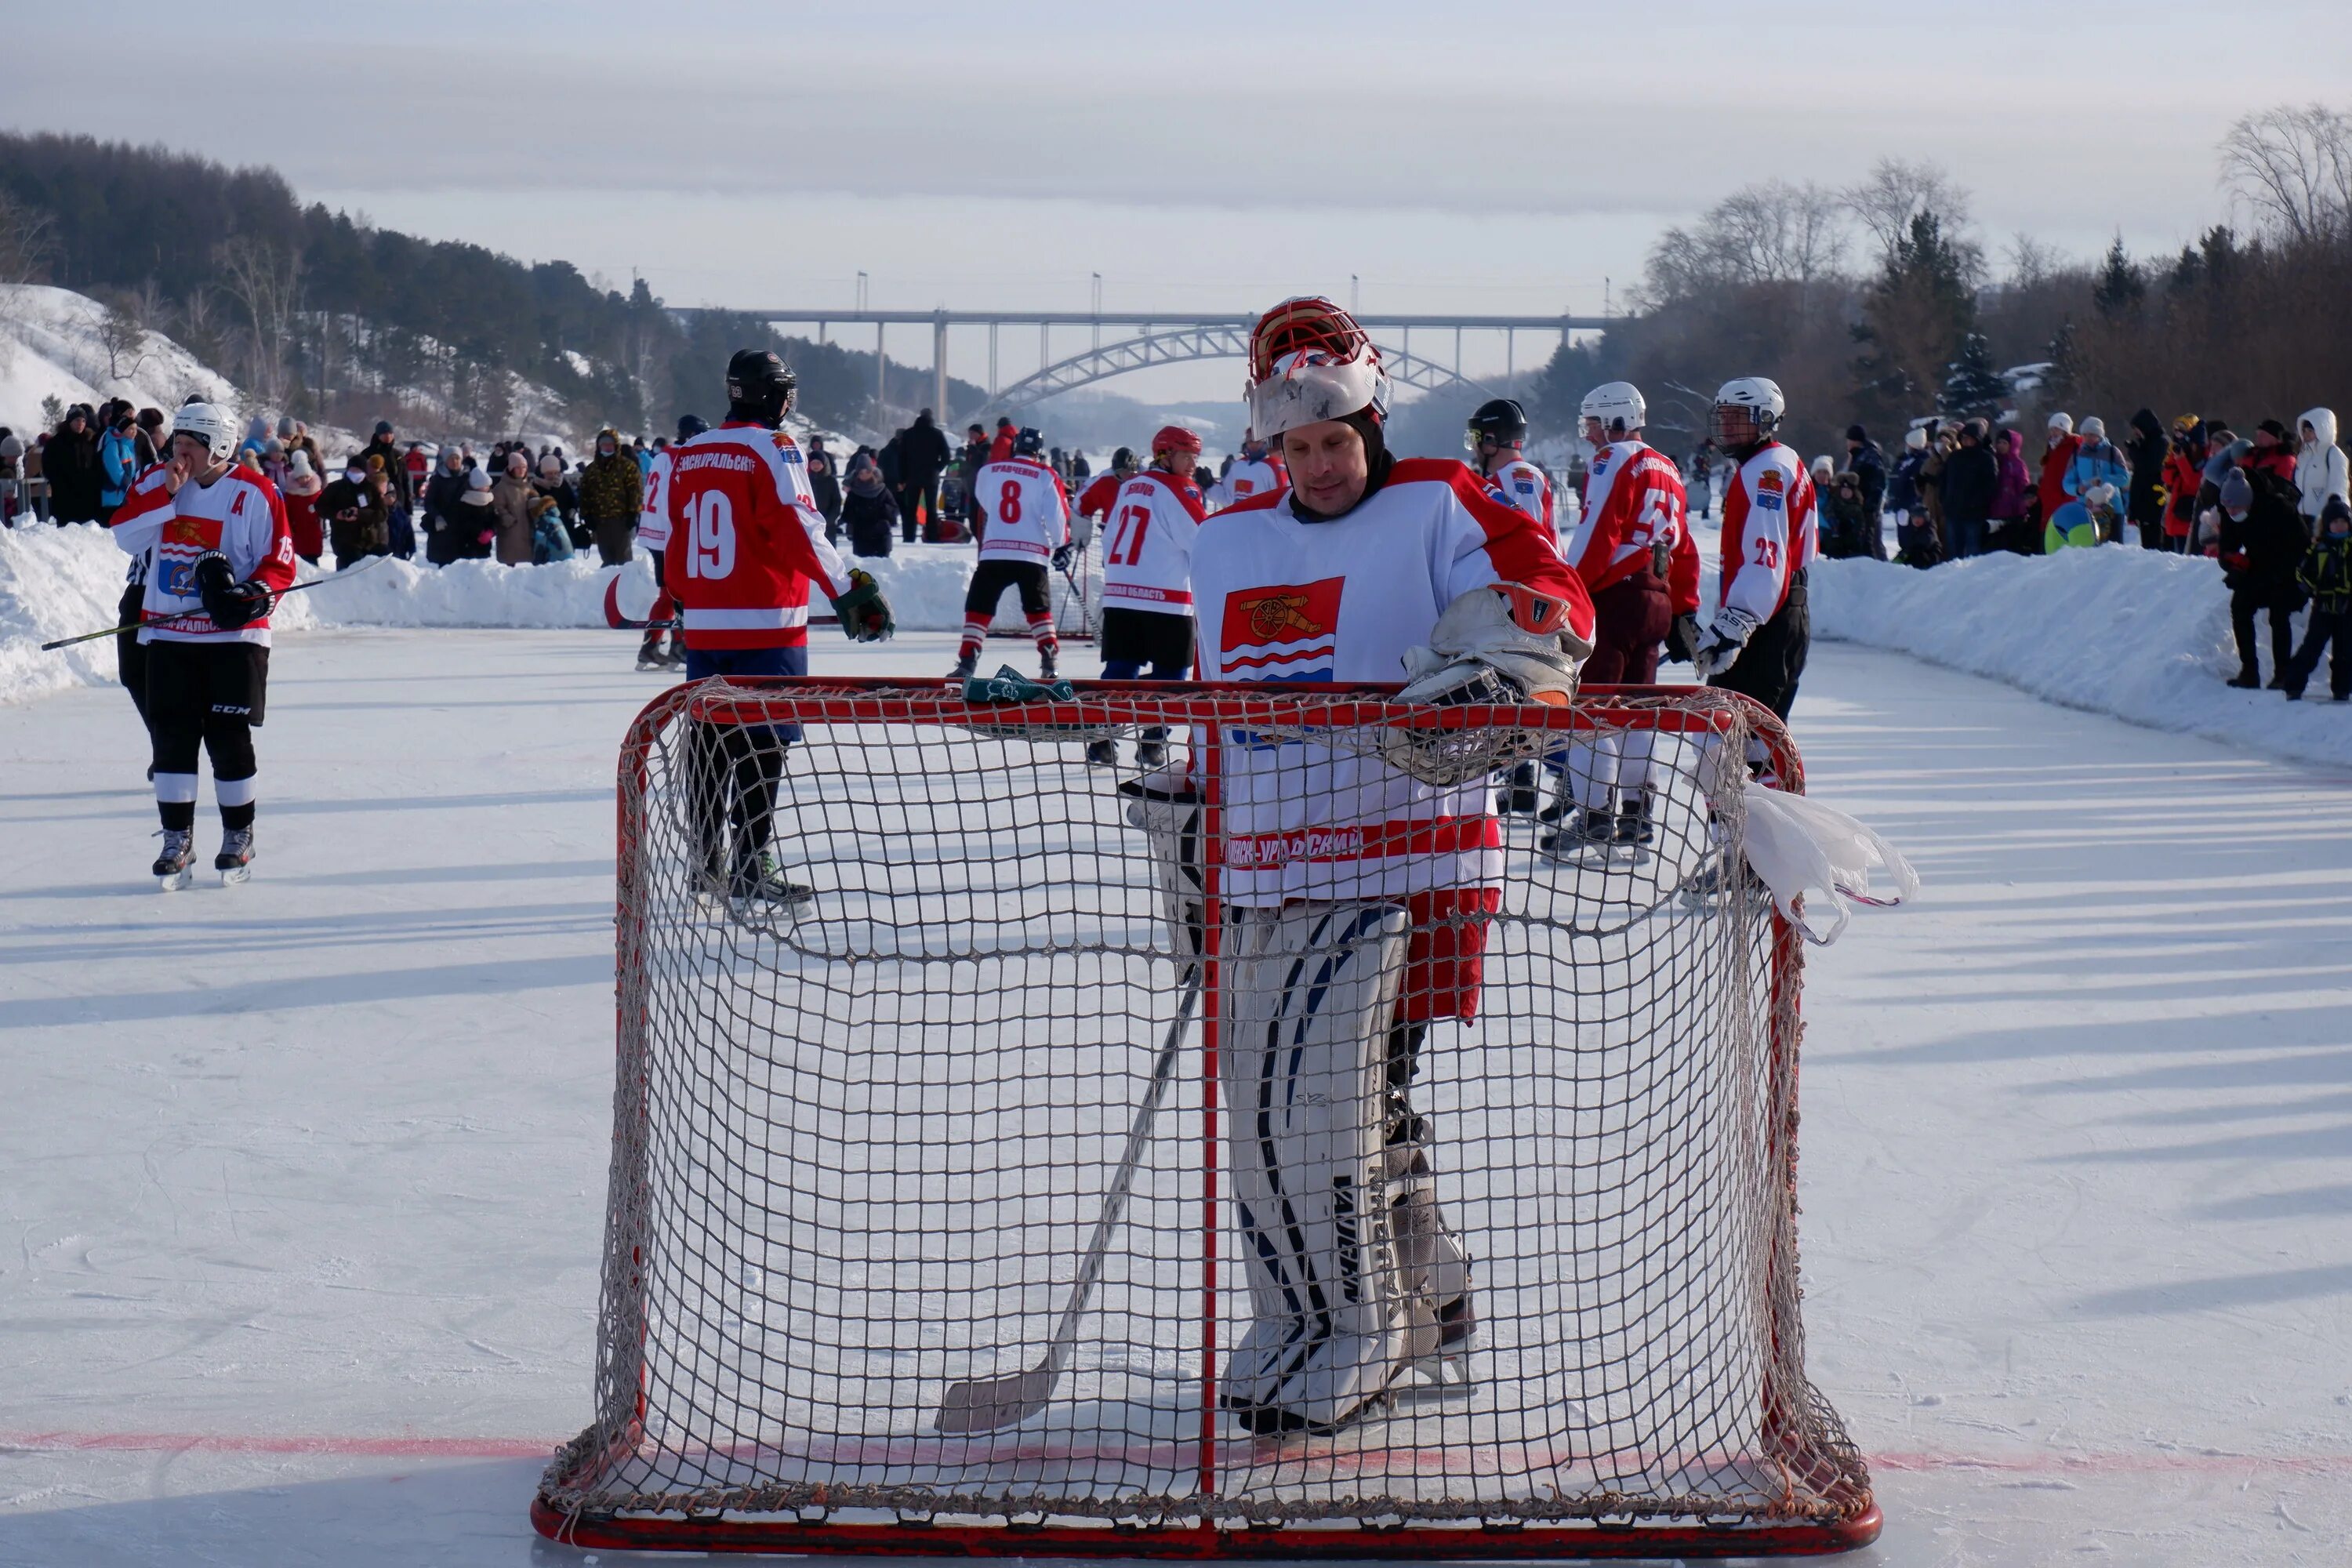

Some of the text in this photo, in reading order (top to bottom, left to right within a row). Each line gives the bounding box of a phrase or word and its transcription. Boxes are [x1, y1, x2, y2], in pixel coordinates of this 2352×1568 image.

[1000, 480, 1022, 524] 8
[277, 535, 294, 565] 15
[683, 489, 736, 580] 19
[1108, 504, 1152, 566] 27
[1753, 537, 1778, 570] 23
[1127, 586, 1167, 601] ОБЛАСТЬ
[211, 704, 252, 716] CCM
[1334, 1175, 1360, 1305] VAUGHN
